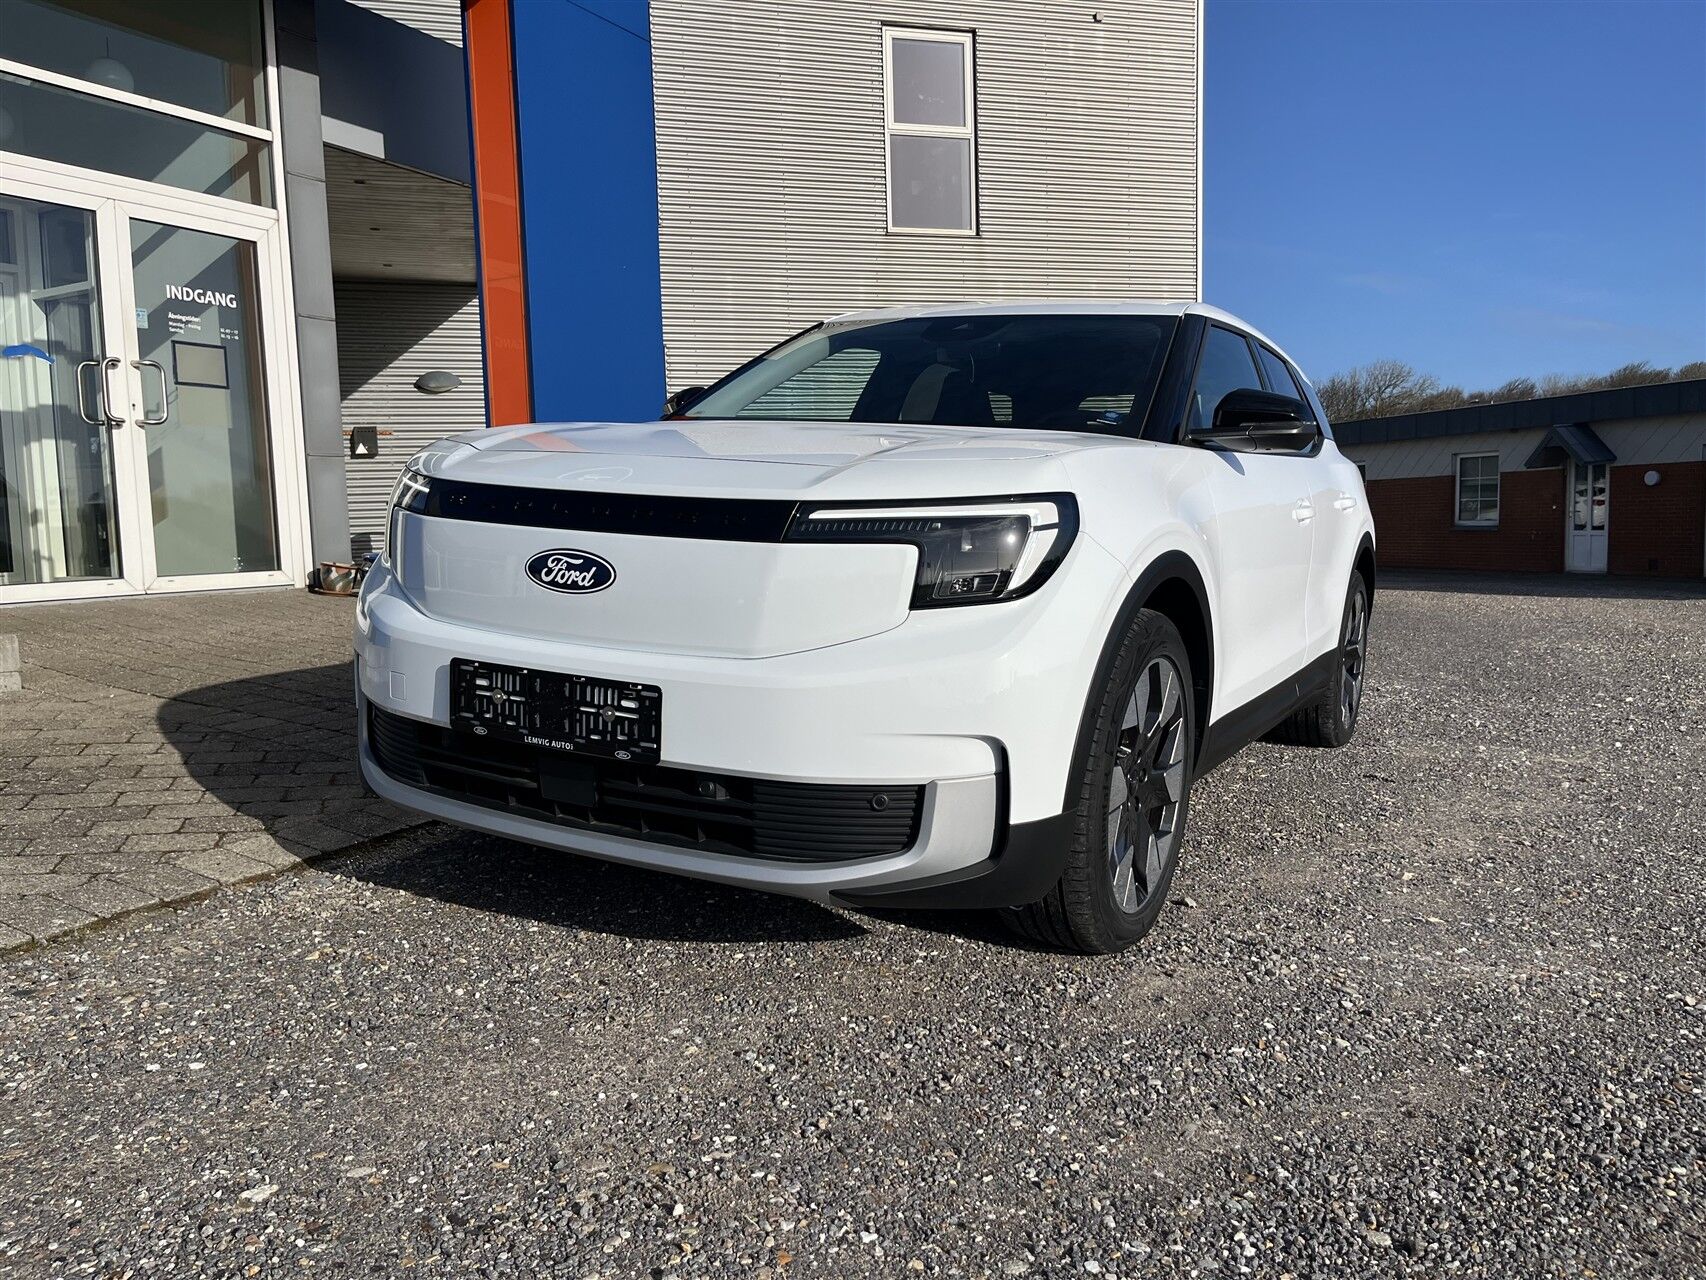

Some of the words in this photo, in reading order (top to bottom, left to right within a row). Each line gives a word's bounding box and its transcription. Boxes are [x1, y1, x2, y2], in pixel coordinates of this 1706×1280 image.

[165, 284, 237, 309] INDGANG
[541, 555, 597, 587] Ford
[524, 735, 550, 746] LEMVIG
